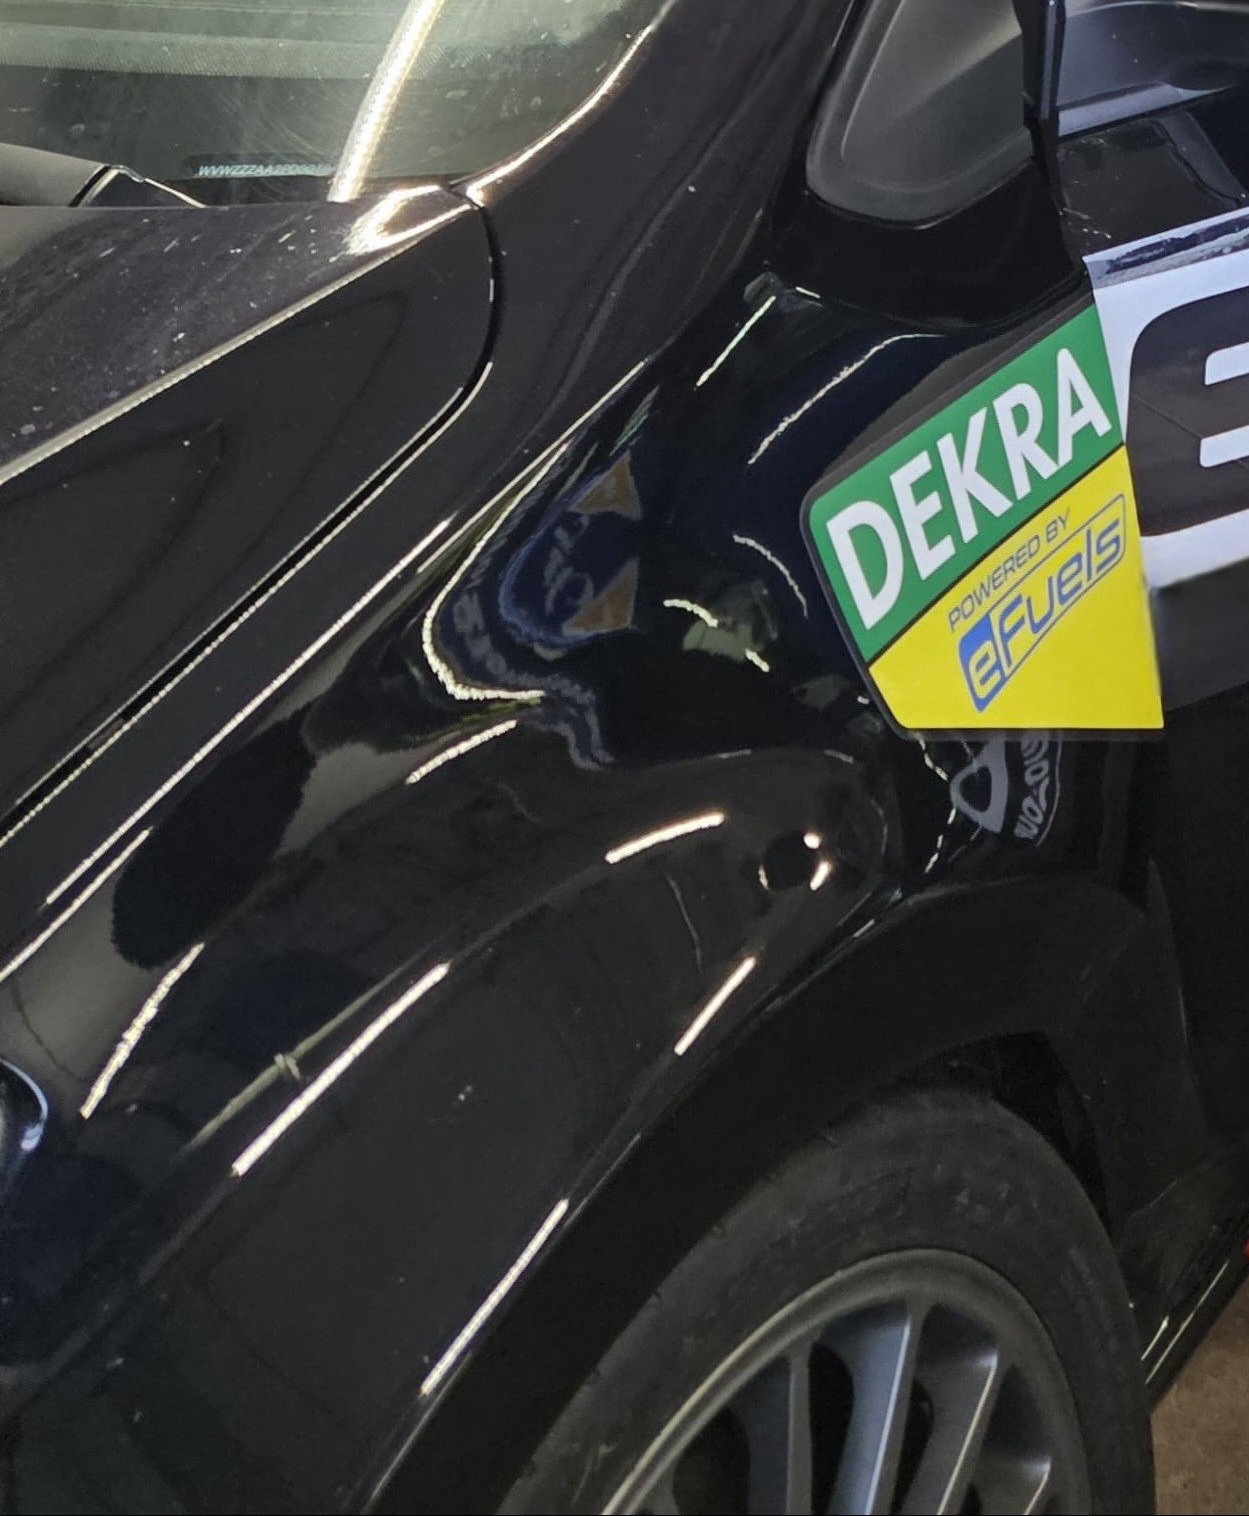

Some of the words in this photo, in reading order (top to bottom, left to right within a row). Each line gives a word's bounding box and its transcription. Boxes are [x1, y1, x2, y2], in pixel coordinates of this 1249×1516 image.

[825, 348, 1112, 631] DEKRA
[948, 534, 1040, 633] POWERED
[1044, 506, 1070, 544] BY
